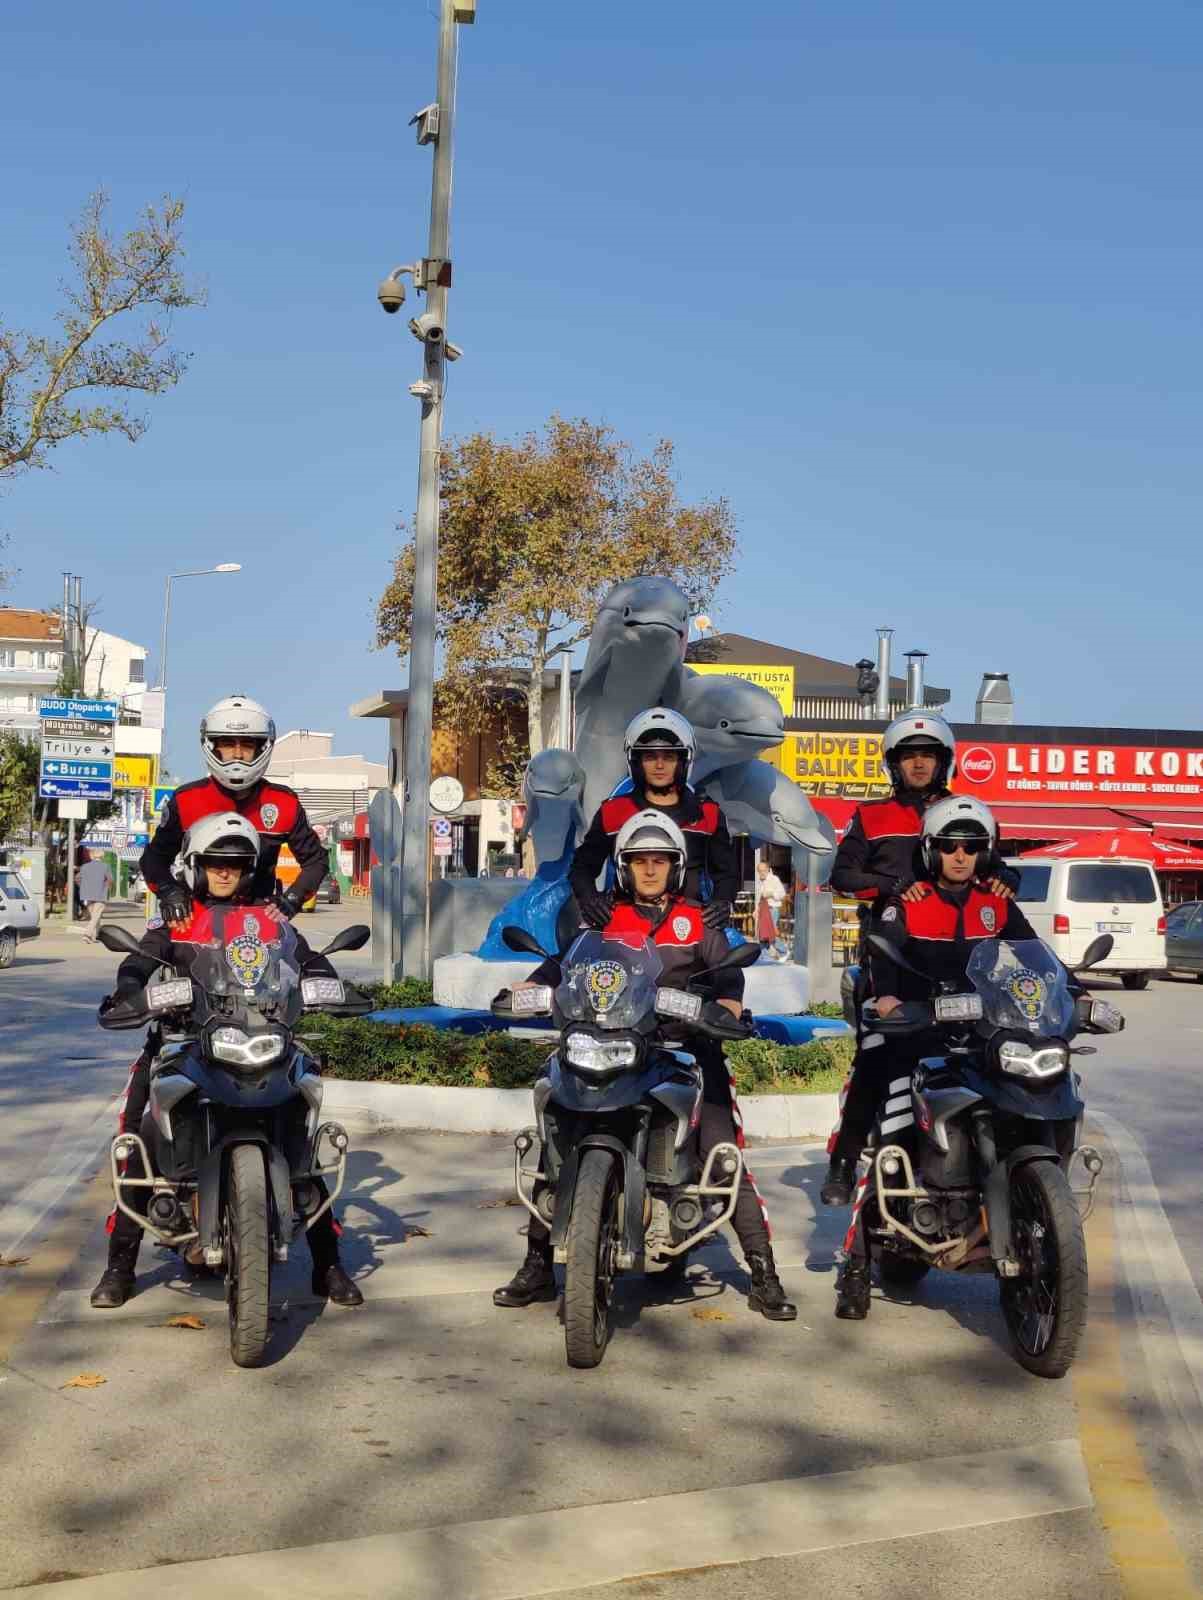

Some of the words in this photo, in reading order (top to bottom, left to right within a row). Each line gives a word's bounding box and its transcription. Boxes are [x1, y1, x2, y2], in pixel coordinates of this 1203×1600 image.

[765, 672, 790, 682] USTA
[40, 700, 65, 710] BUDO
[46, 741, 91, 756] Trilye
[796, 732, 860, 755] MİDYE
[60, 763, 98, 775] Bursa
[796, 757, 859, 777] BALIK
